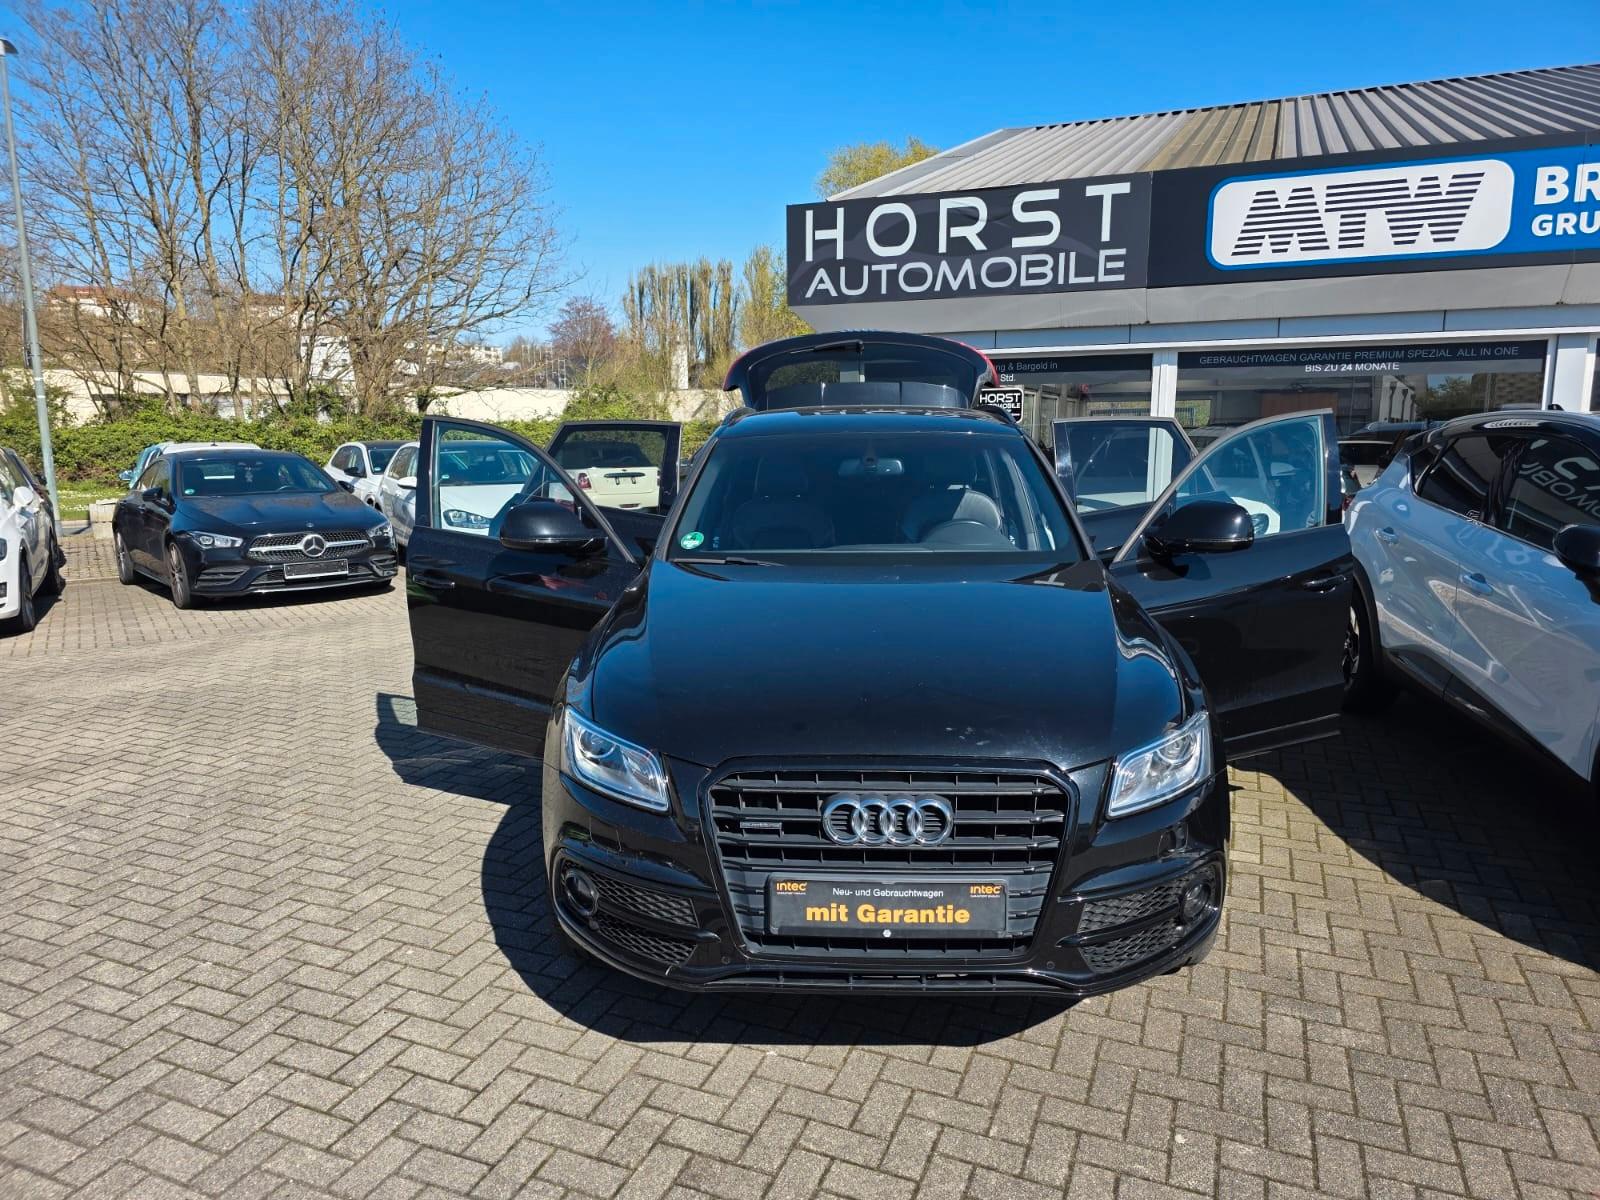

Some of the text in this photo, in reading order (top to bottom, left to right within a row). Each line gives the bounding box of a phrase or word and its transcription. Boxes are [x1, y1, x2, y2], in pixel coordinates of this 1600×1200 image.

[1230, 172, 1485, 256] MTW
[805, 182, 1131, 262] HORST
[1531, 210, 1600, 236] GRU
[805, 248, 1127, 298] AUTOMOBILE
[1200, 347, 1519, 364] GEBRAUCHTWAGEN GARANTIE PREMIUM SPEZIAL ALL IN ONE
[1007, 362, 1014, 370] &
[1050, 360, 1058, 369] in
[1305, 362, 1400, 372] BIS ZU 24 MONATE
[1000, 373, 1016, 382] Std.
[979, 392, 1021, 404] HORST
[776, 881, 808, 891] intec
[970, 885, 1002, 894] intec
[832, 887, 944, 899] Neu- und Gebrauchtwagen
[806, 903, 970, 923] mit Garantie
